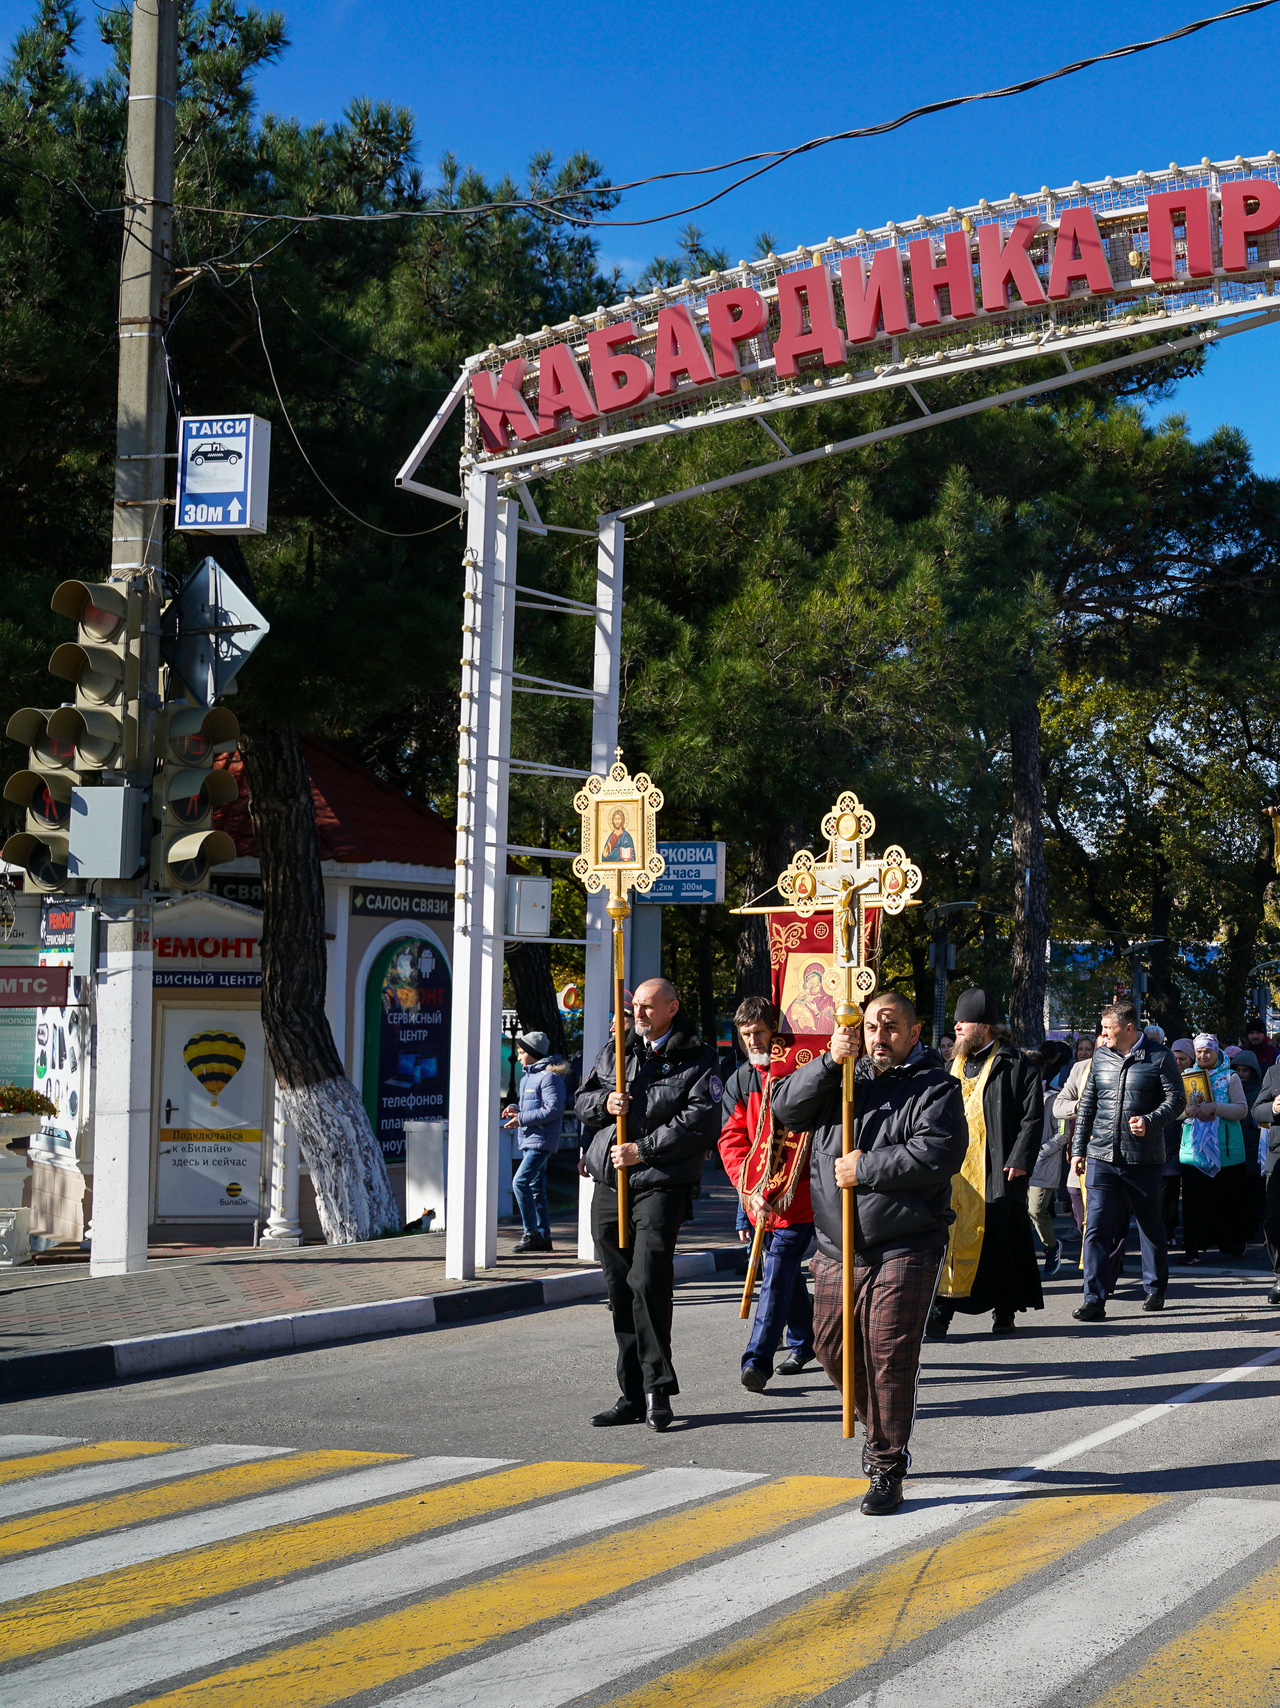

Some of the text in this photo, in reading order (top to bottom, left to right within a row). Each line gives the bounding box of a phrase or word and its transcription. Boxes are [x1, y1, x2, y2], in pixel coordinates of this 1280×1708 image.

[471, 206, 1116, 454] КАБАРДИНКА
[189, 420, 247, 436] ТАКСИ
[184, 504, 223, 523] 30м
[657, 847, 714, 862] РКОВКА
[673, 868, 701, 879] часа
[223, 884, 263, 900] СВЯ
[682, 882, 703, 891] 300м
[366, 894, 449, 914] САЛОН СВЯЗИ
[49, 911, 75, 930] РЕМОНТ
[136, 930, 150, 943] 82
[0, 977, 48, 994] МТС
[153, 973, 263, 986] ВИСНЫЙ ЦЕНТР
[387, 1010, 442, 1025] СЕРВИСНЫЙ
[399, 1029, 428, 1043] ЦЕНТР
[382, 1093, 443, 1110] телефонов
[173, 1130, 243, 1140] Подключайся
[181, 1143, 232, 1153] «Билайн»
[172, 1158, 199, 1167] здесь
[212, 1157, 247, 1167] сейчас
